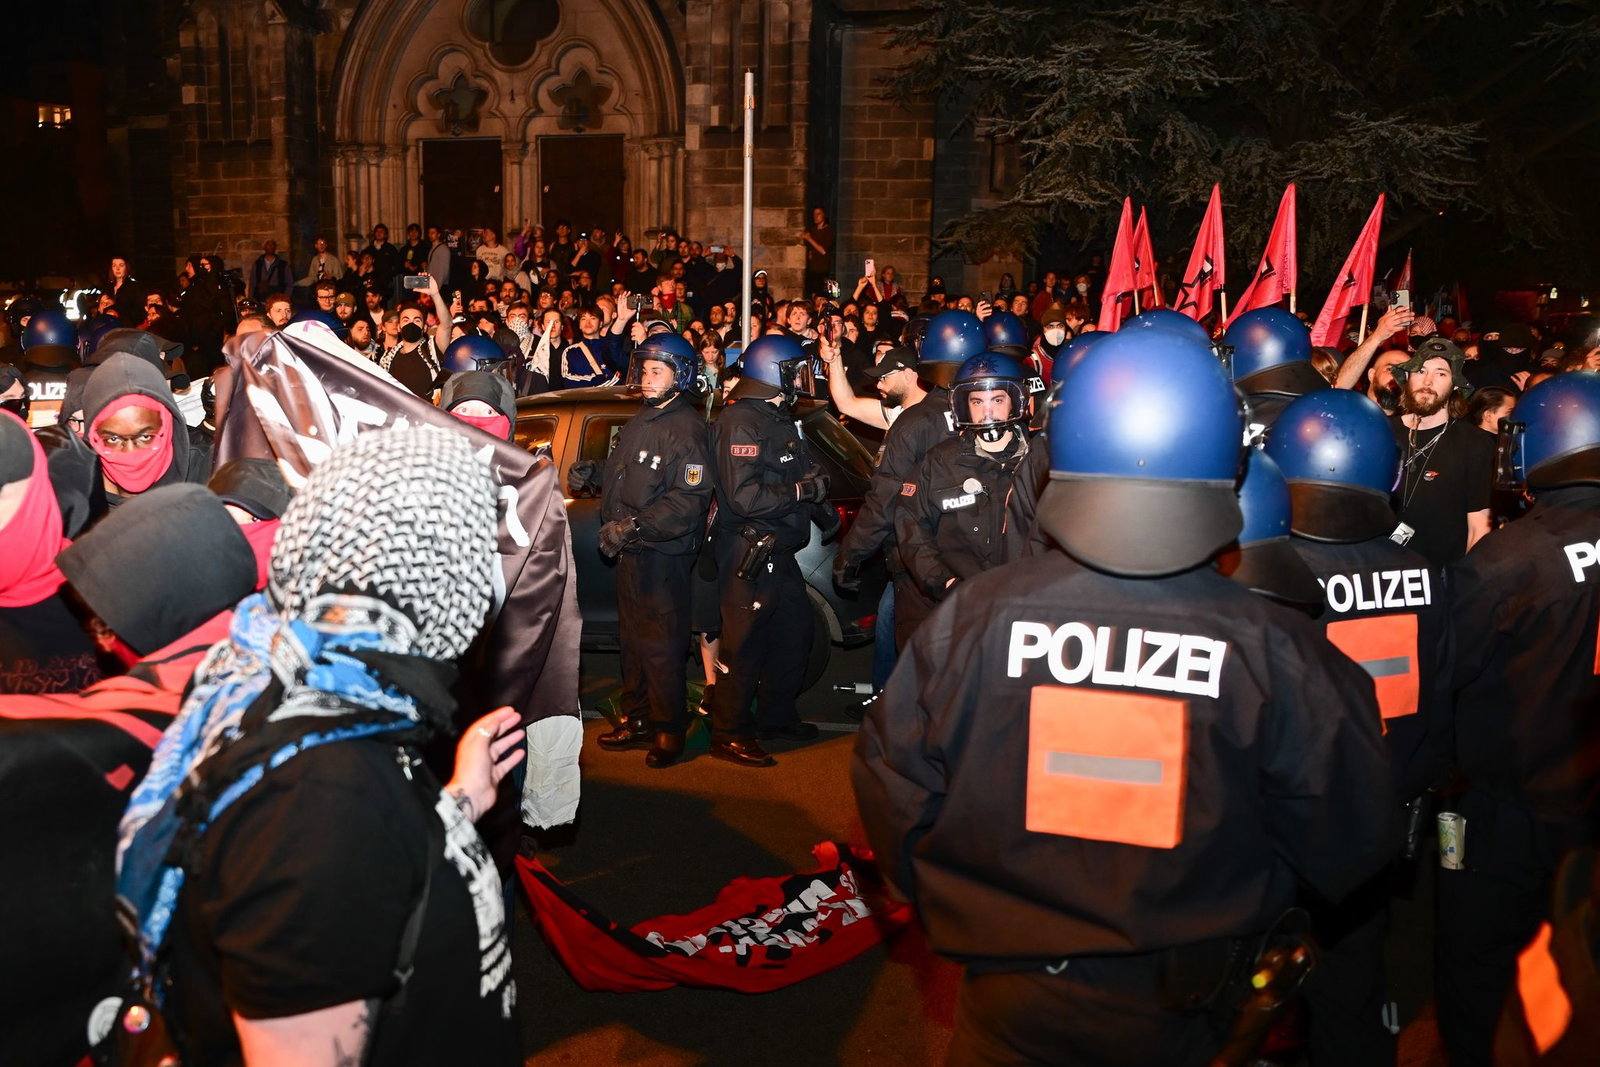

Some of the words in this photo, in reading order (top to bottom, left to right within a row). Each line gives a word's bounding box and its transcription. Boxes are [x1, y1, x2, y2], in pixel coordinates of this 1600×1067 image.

[1563, 538, 1600, 583] P
[1317, 568, 1431, 613] OLIZEI
[1007, 621, 1227, 699] POLIZEI
